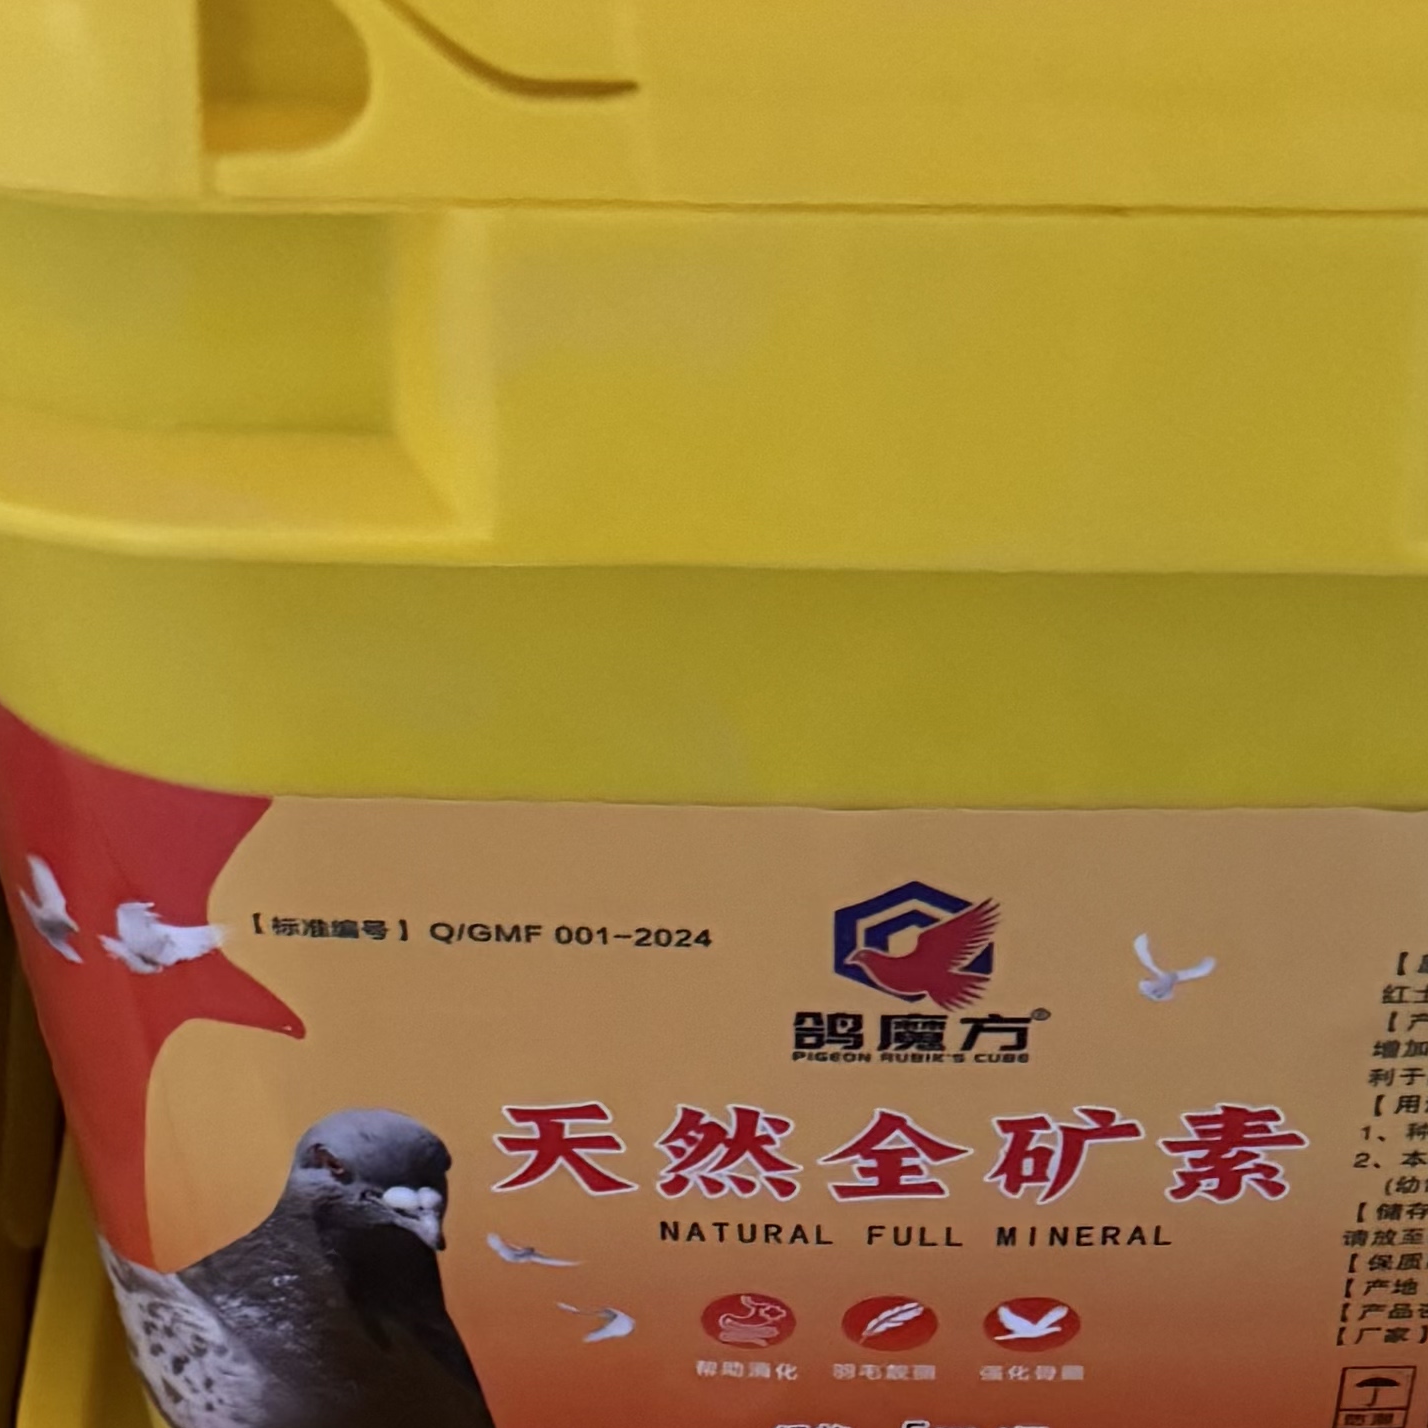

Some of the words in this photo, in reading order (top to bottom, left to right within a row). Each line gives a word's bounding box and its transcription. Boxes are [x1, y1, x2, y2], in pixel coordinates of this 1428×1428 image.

[252, 912, 410, 943] 【标准编号】
[429, 921, 543, 946] Q/GMF
[555, 925, 713, 950] 001-2024
[791, 1051, 872, 1063] PIGEON
[881, 1052, 965, 1064] RUBIK'S
[973, 1053, 1030, 1064] CUBE
[491, 1101, 1310, 1205] 天然全矿素
[659, 1220, 834, 1248] NATURAL
[867, 1224, 963, 1248] FULL
[996, 1225, 1172, 1248] MINERAL
